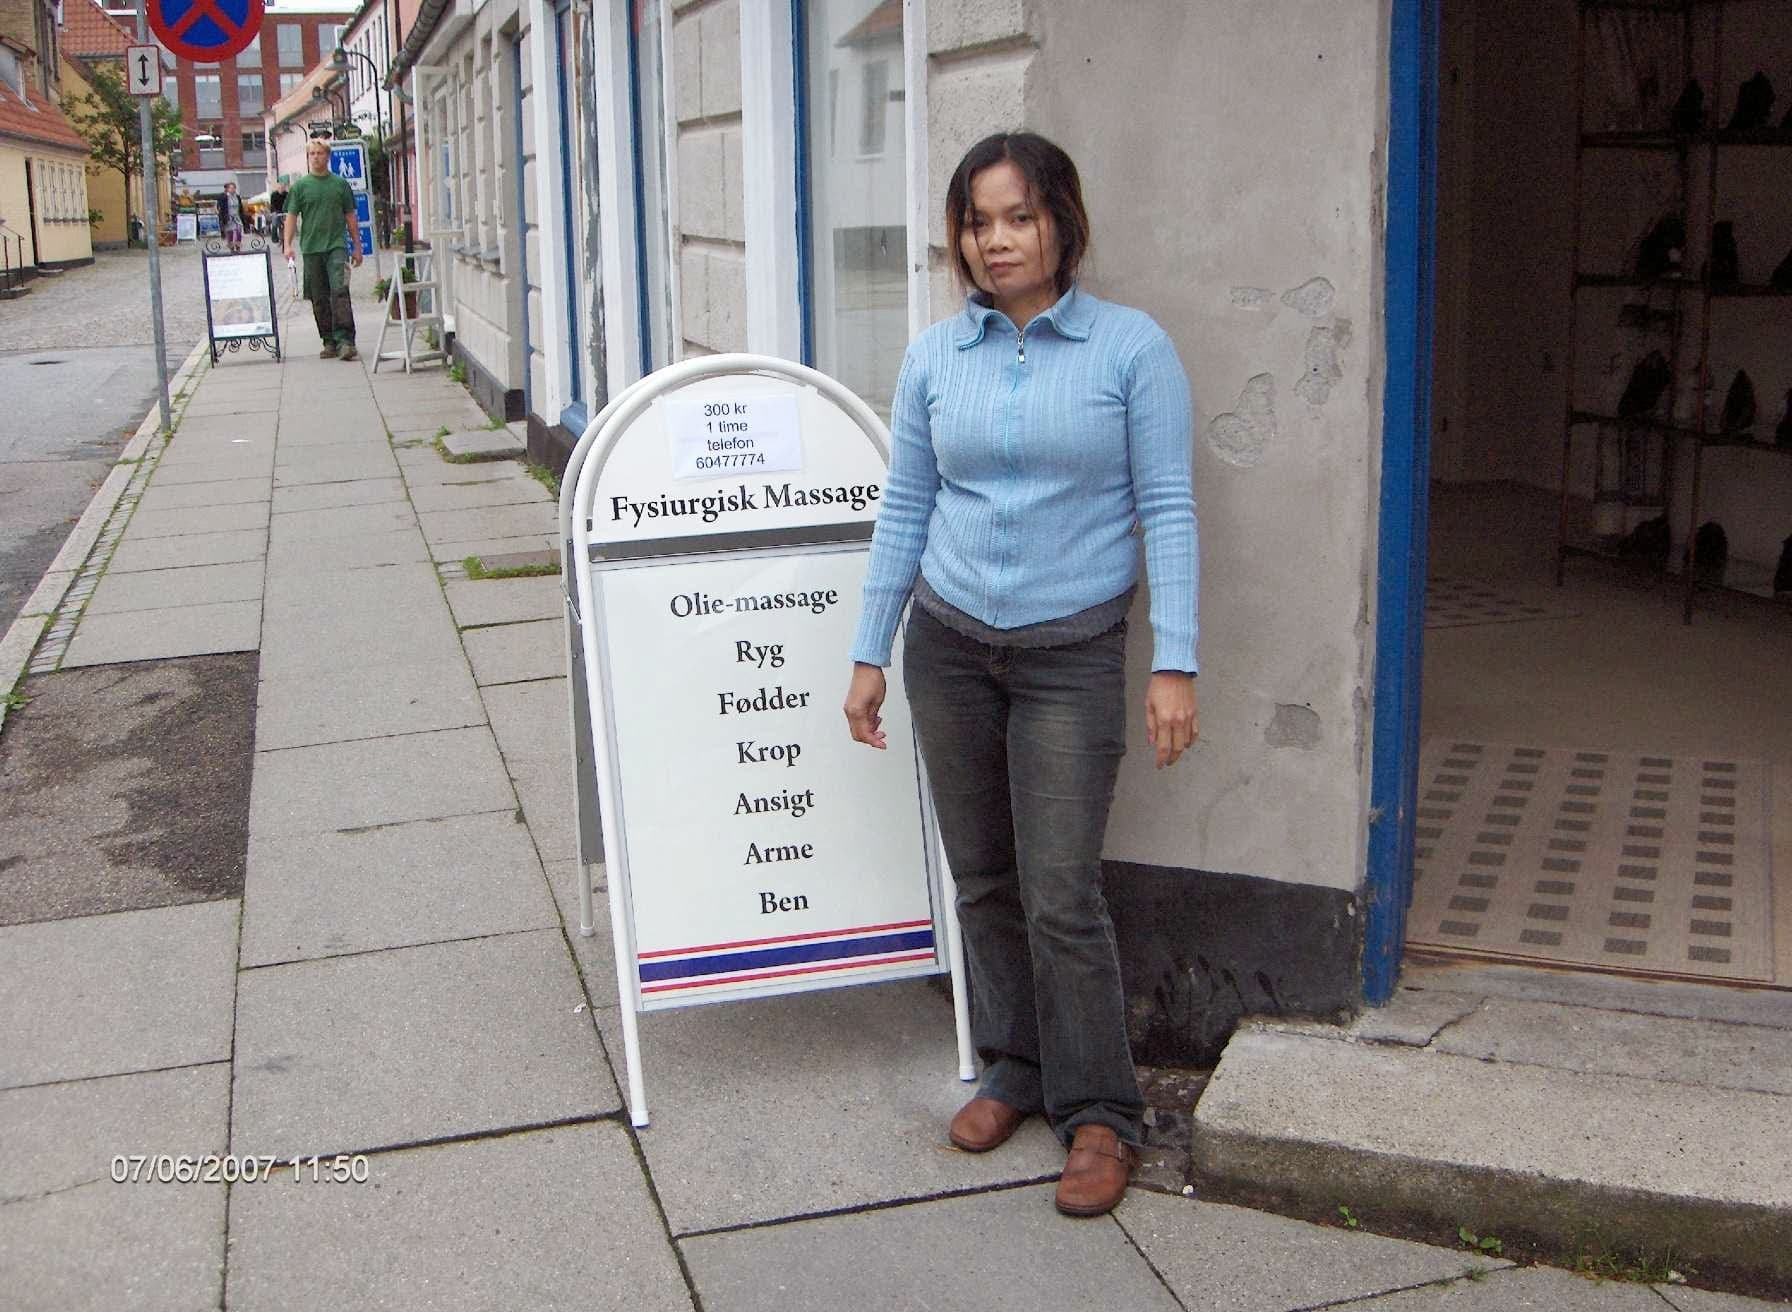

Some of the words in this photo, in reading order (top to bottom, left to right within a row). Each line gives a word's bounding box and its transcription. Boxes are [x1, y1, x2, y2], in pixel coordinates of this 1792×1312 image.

[704, 403, 730, 417] 300
[735, 402, 748, 415] kr
[706, 421, 713, 434] 1
[719, 420, 748, 433] time
[707, 437, 755, 452] telefon
[696, 452, 766, 470] 60477774
[610, 484, 759, 527] Fysiurgisk
[761, 482, 881, 511] Massage
[669, 588, 840, 618] Olie-massage
[735, 640, 786, 669] Ryg
[717, 686, 810, 715] Fødder
[735, 740, 802, 768] Krop
[733, 788, 816, 818] Ansigt
[743, 842, 815, 865] Arme
[759, 891, 810, 915] Ben
